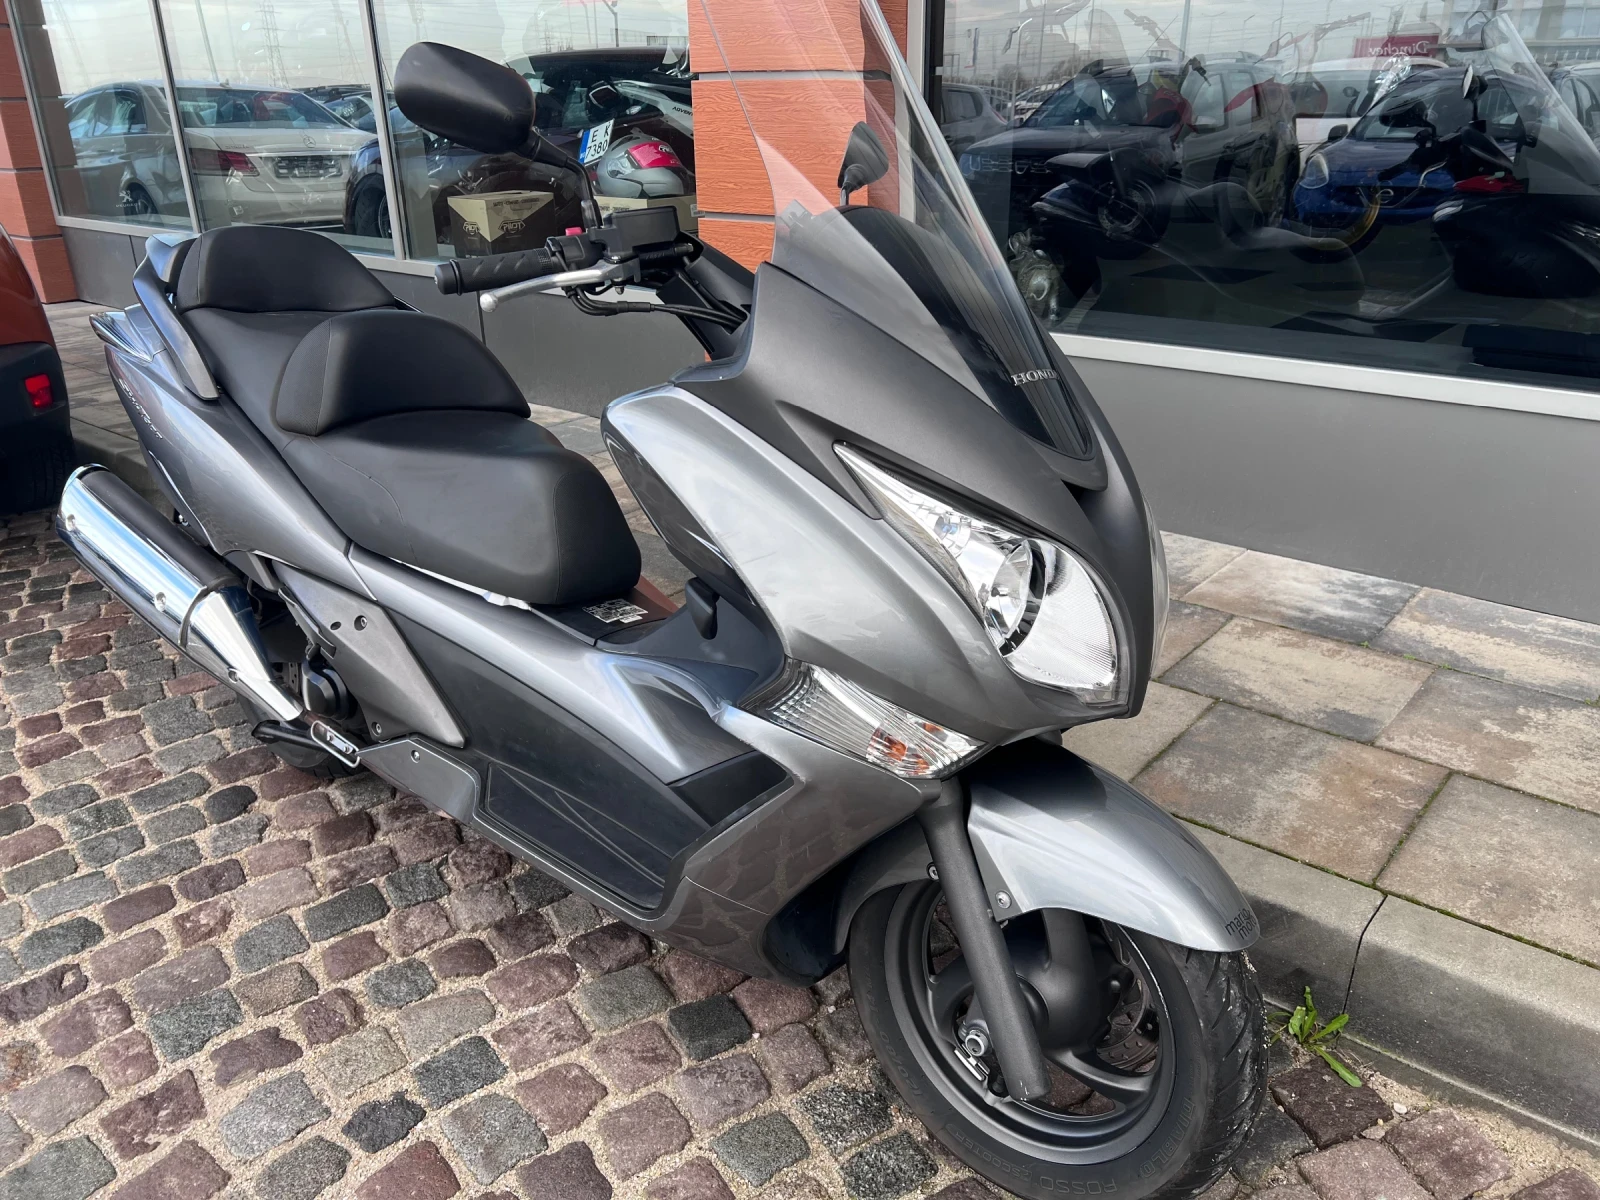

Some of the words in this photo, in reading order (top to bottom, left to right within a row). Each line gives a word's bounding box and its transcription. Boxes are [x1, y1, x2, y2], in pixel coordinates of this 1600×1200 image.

[591, 129, 599, 142] E
[585, 140, 608, 159] 7380
[1224, 908, 1249, 936] mario
[1140, 1097, 1197, 1179] DIABLO
[954, 1130, 1025, 1179] SCOOTER
[1039, 1176, 1118, 1195] ROSSO
